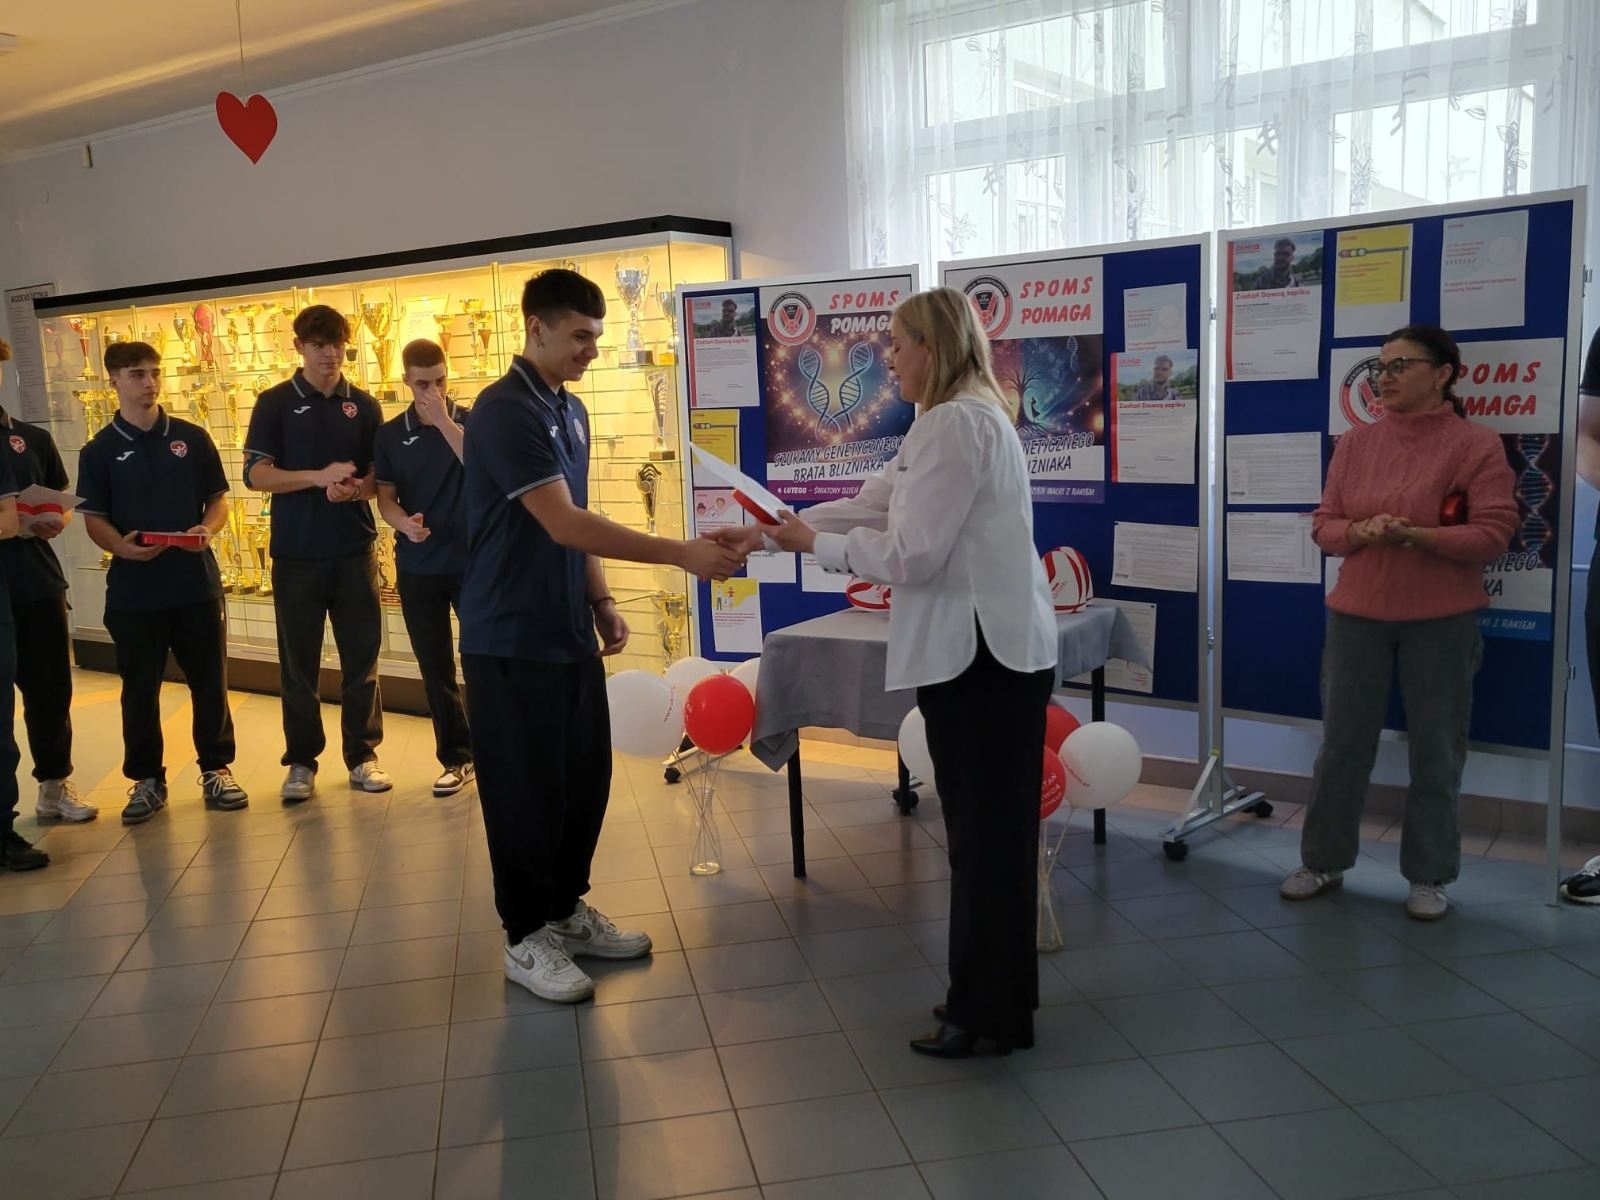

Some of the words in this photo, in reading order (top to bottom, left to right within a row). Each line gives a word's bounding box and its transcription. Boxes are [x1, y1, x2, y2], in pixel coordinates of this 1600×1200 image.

[1020, 276, 1093, 298] SPOMS
[829, 290, 899, 310] SPOMS
[1021, 303, 1091, 324] POMAGA
[1458, 361, 1542, 384] POMS
[1464, 394, 1536, 416] MAGA
[1022, 431, 1095, 455] NETYCZNEGO
[774, 447, 821, 467] SZUKAMY
[1028, 455, 1071, 474] IŹNIAKA
[793, 466, 825, 482] BRATA
